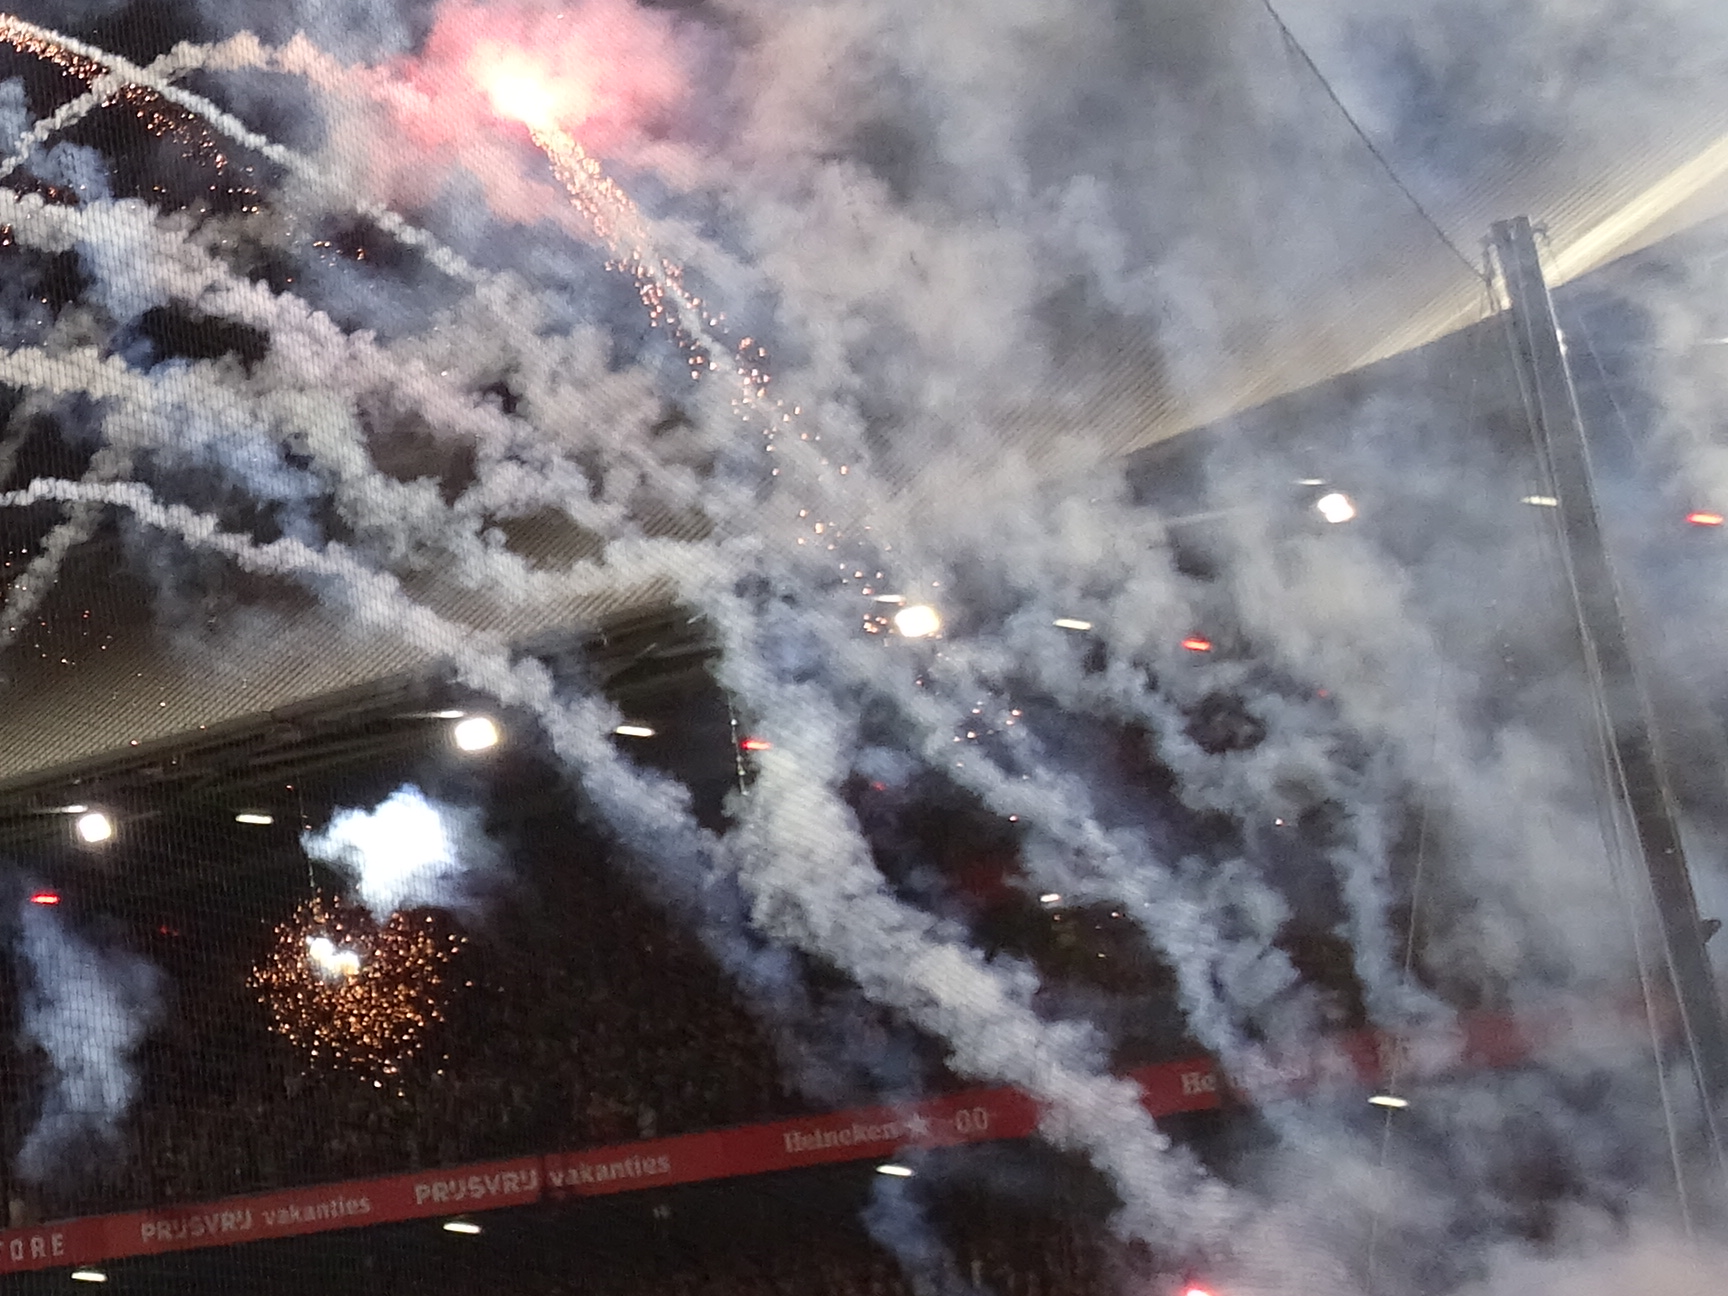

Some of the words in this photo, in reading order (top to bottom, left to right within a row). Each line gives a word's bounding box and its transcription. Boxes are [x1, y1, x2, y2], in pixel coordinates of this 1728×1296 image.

[783, 1121, 901, 1153] Heineken
[549, 1153, 670, 1188] vakanties
[262, 1196, 371, 1227] vakanties
